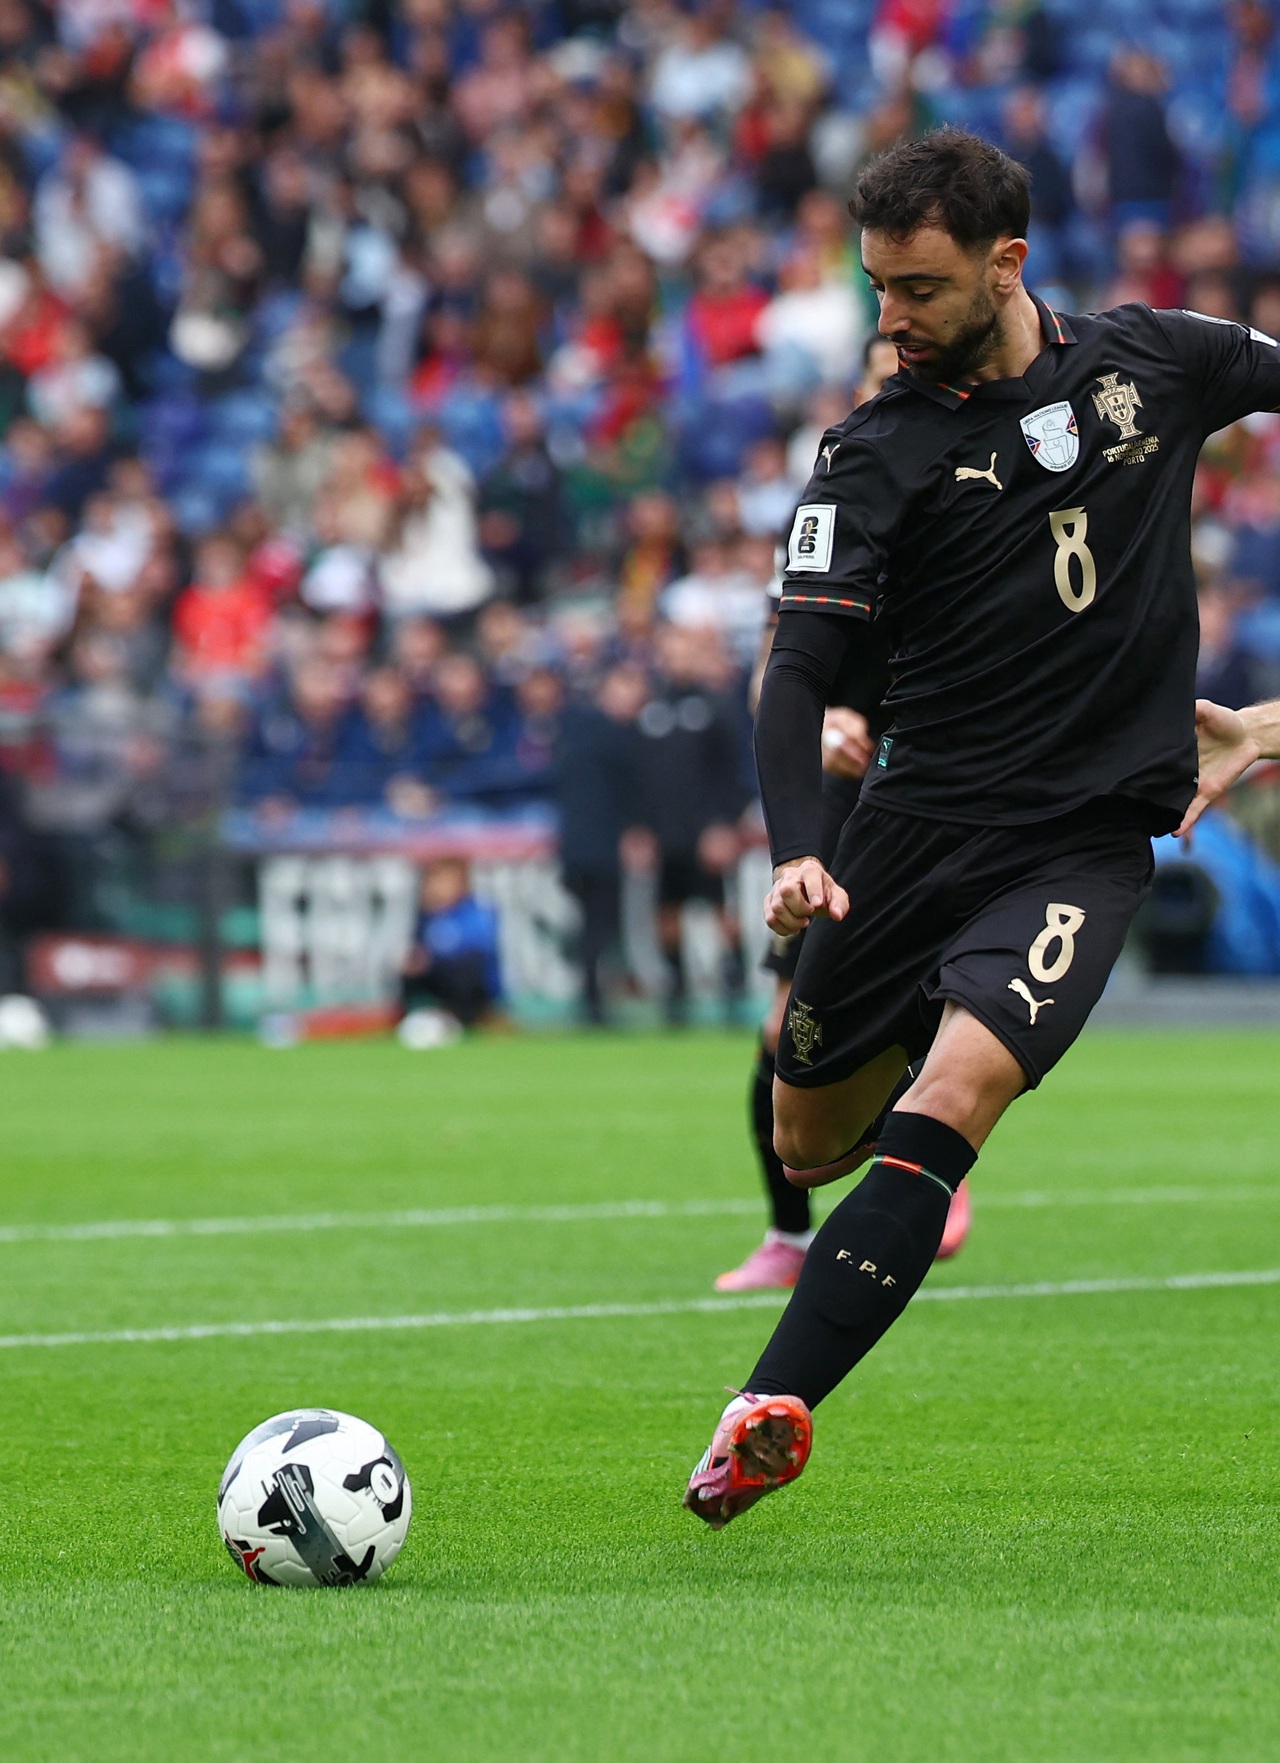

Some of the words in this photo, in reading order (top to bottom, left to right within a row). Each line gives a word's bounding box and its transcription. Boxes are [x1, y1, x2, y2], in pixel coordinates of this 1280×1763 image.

[1123, 454, 1145, 466] PORTO
[1048, 506, 1097, 613] 8
[1028, 902, 1086, 983] 8
